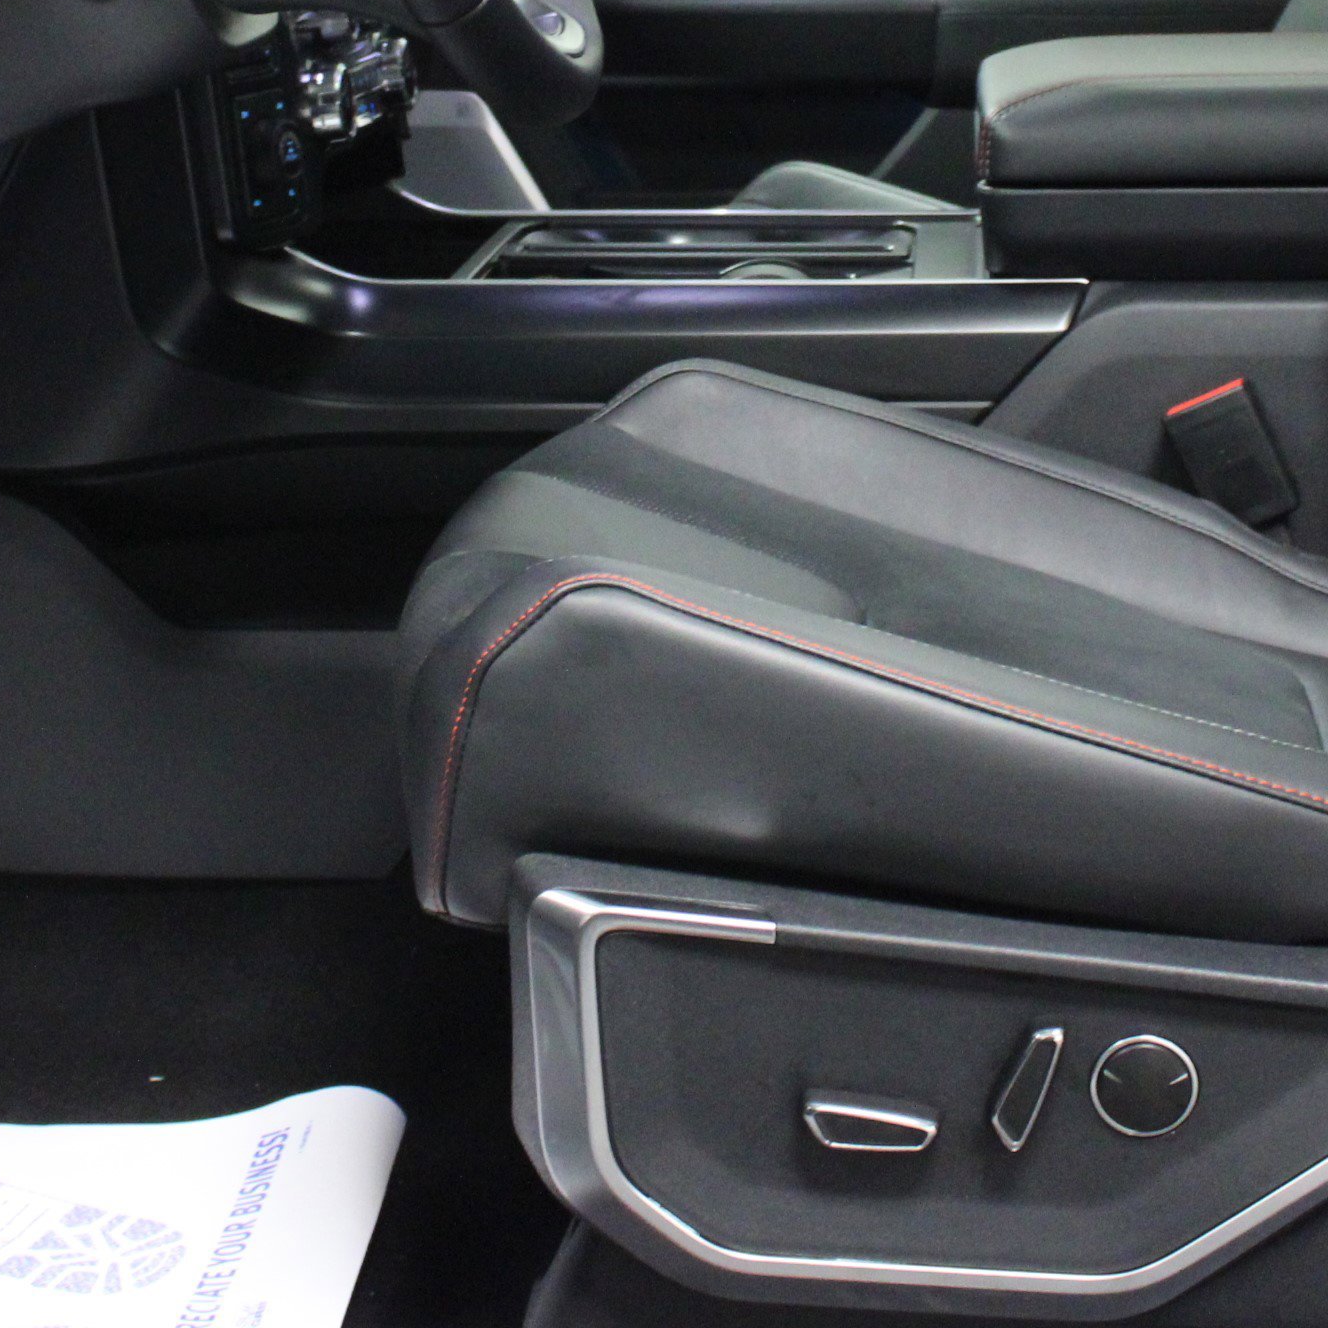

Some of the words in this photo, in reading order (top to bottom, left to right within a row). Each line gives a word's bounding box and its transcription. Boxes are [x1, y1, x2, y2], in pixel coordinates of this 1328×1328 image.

[230, 1126, 291, 1218] BUSINESS!
[207, 1218, 257, 1268] YOUR
[175, 1269, 236, 1328] ECIATE
